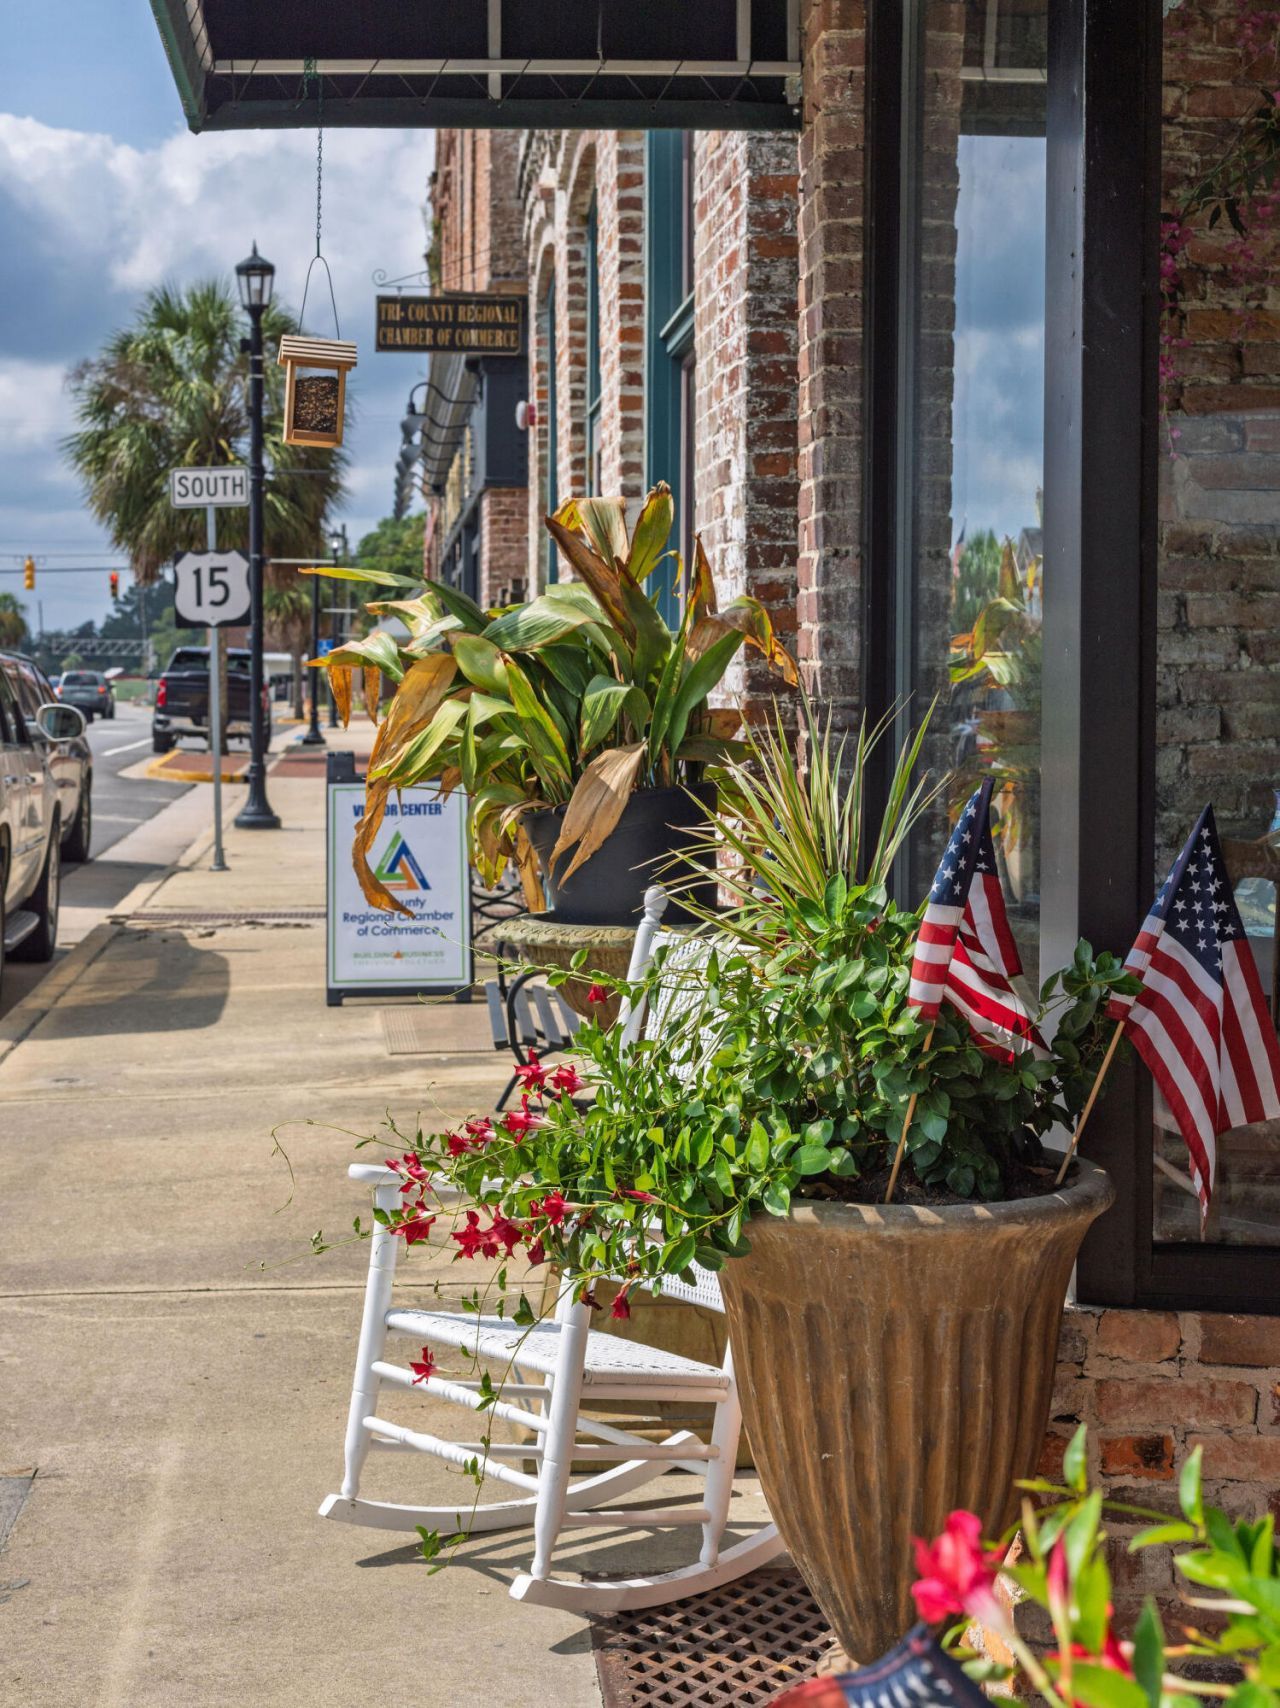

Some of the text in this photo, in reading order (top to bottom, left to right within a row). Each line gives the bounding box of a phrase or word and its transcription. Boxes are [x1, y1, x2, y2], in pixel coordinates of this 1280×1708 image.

[458, 304, 518, 323] REGIONAL
[379, 327, 518, 347] CHAMBER OF COMMERCE
[177, 475, 244, 498] SOUTH
[193, 567, 230, 607] 15
[353, 803, 442, 817] VIOR CENTER
[342, 910, 454, 925] Regional Camber
[357, 925, 440, 936] of Commerce
